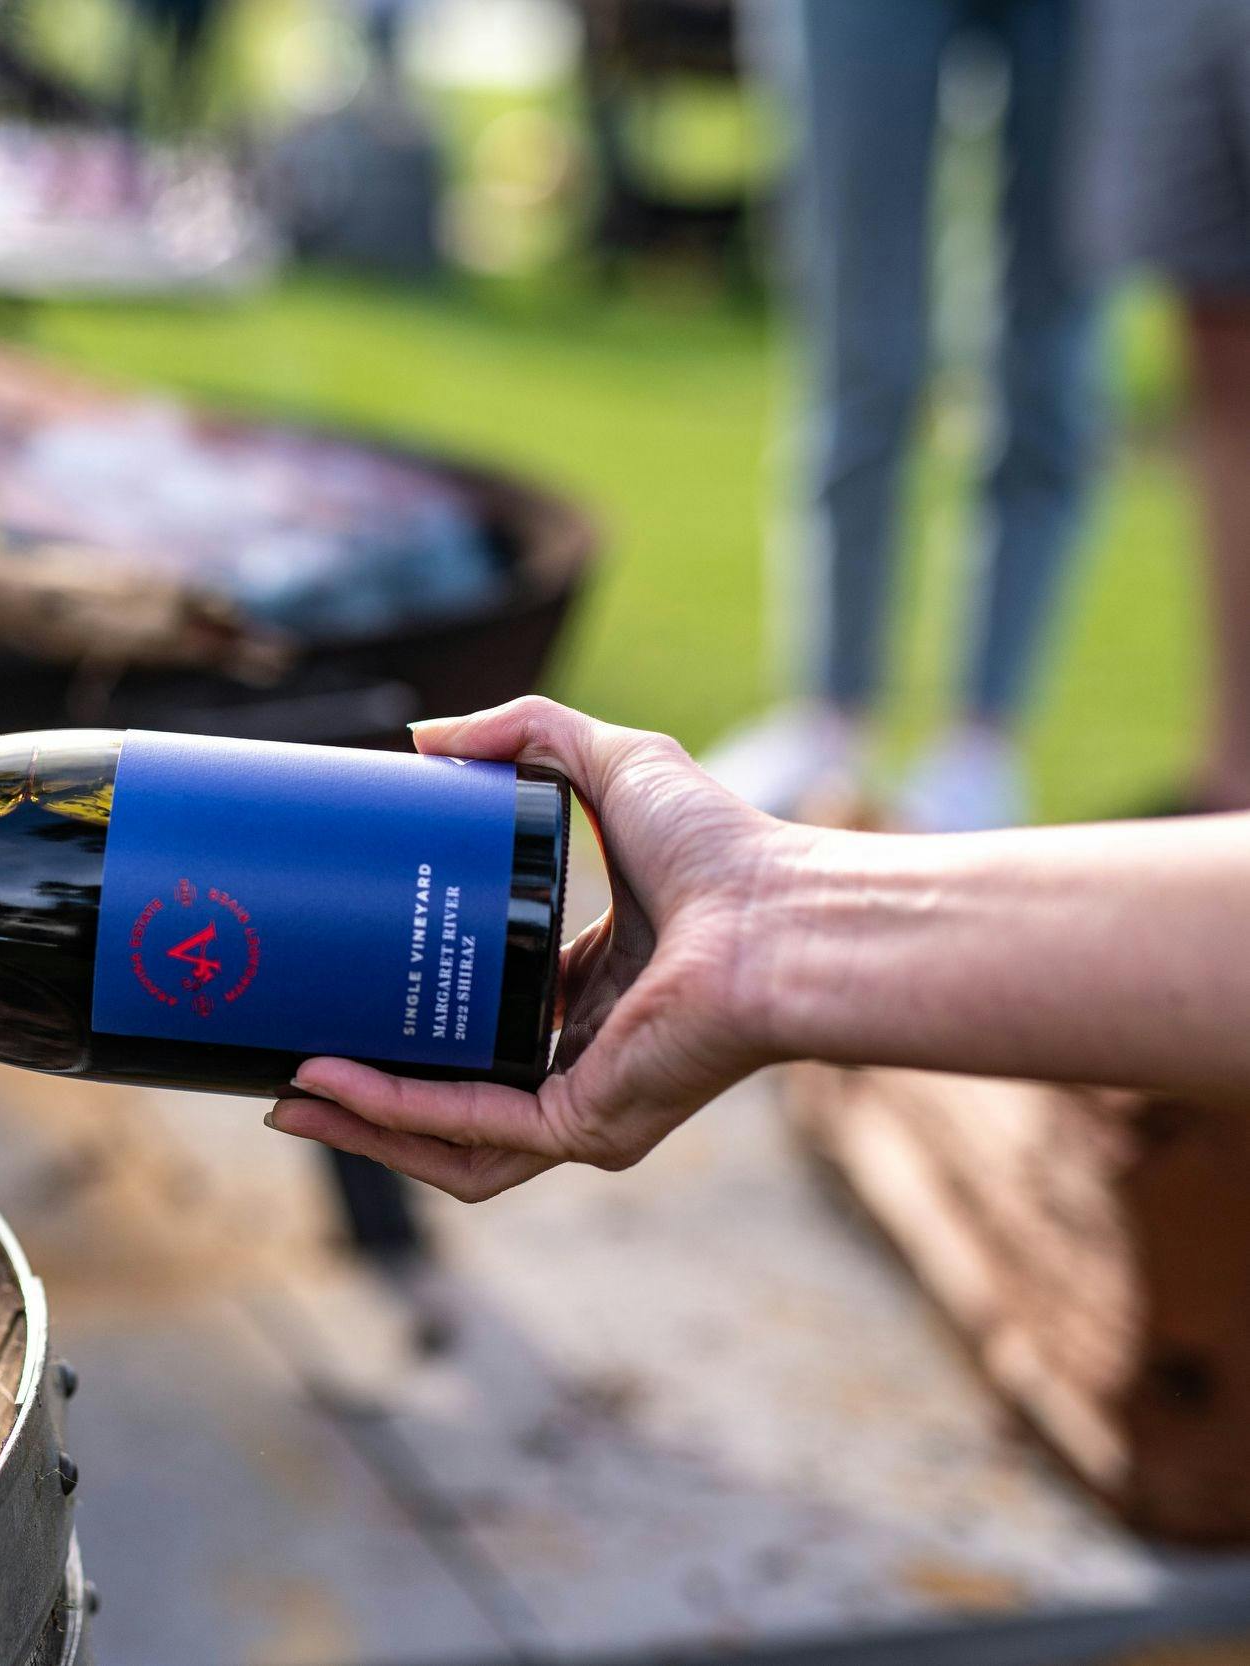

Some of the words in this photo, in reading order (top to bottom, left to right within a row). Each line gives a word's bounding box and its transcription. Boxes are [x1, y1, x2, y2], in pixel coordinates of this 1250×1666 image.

[410, 863, 432, 963] VINEYARD
[442, 886, 460, 941] RIVER
[432, 944, 455, 1038] MARGARET
[456, 935, 475, 1002] SHIRAZ
[403, 970, 422, 1036] SINGLE
[454, 1005, 469, 1040] 2022
